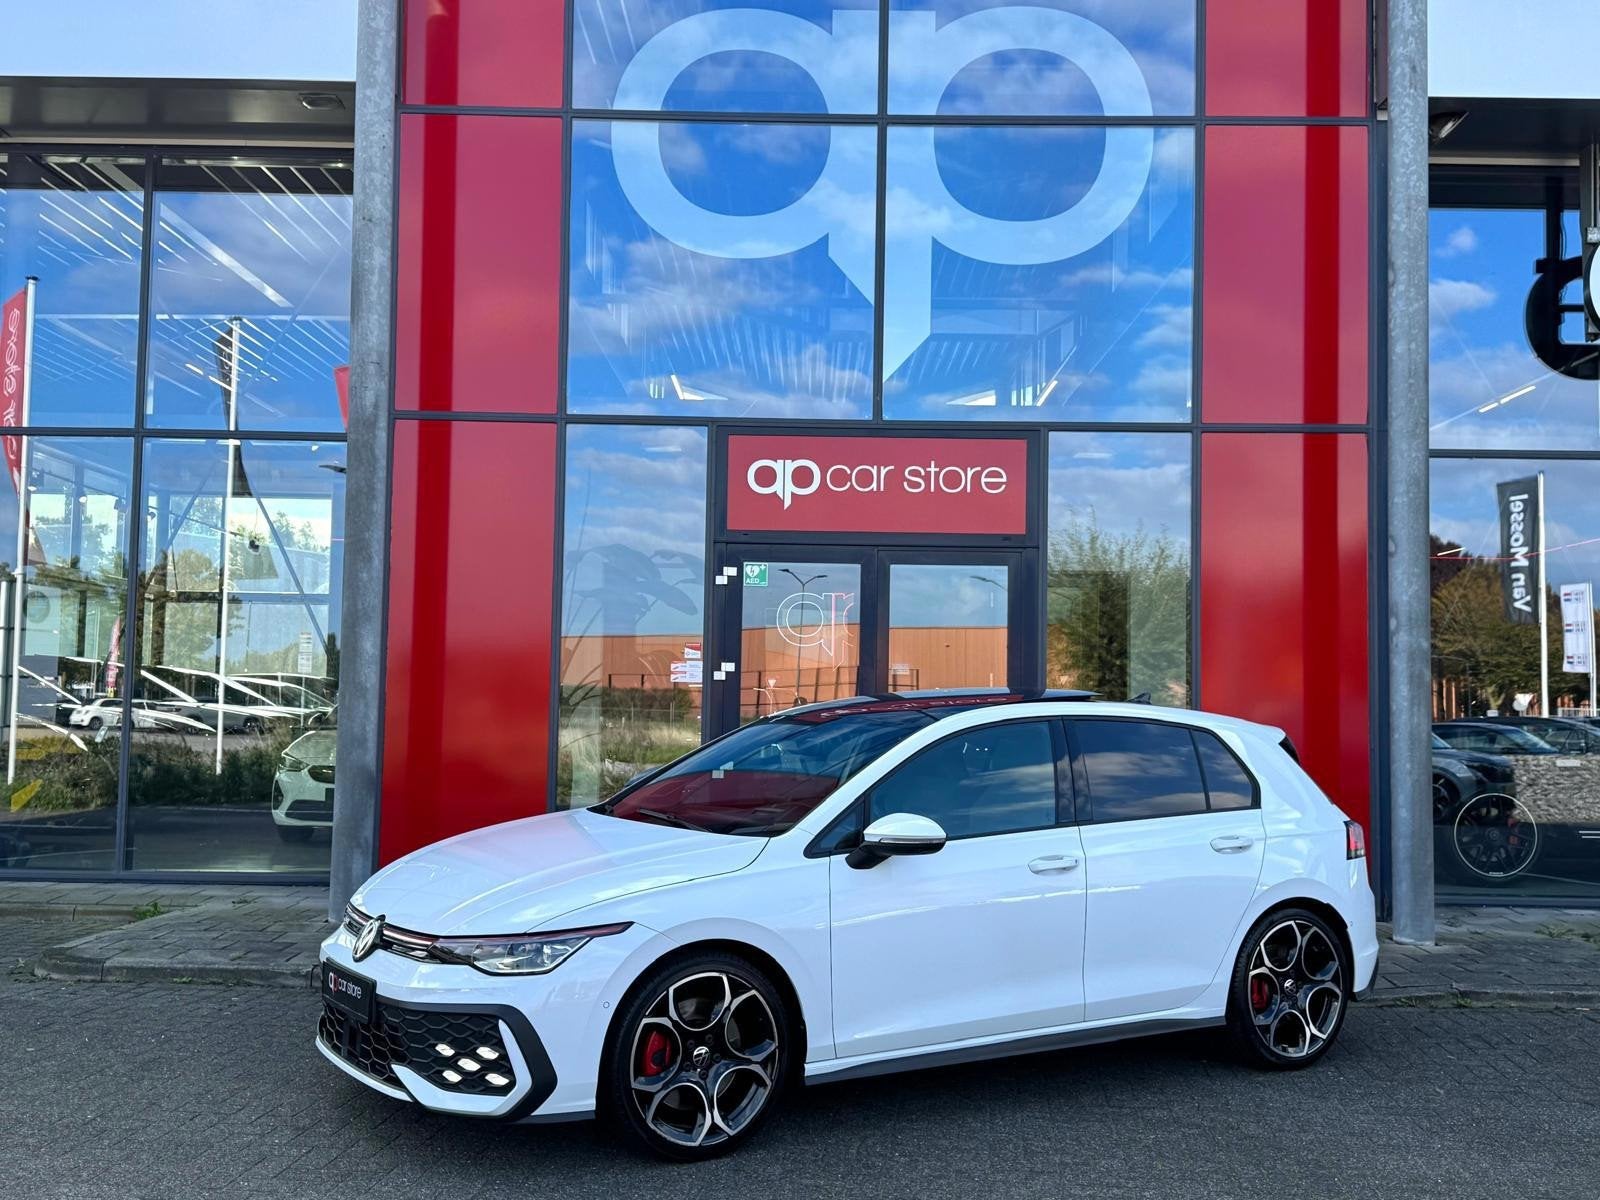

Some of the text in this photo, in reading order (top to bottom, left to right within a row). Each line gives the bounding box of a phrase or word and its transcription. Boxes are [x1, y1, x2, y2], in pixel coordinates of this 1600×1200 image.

[747, 459, 1007, 510] ap car store
[347, 982, 362, 999] store
